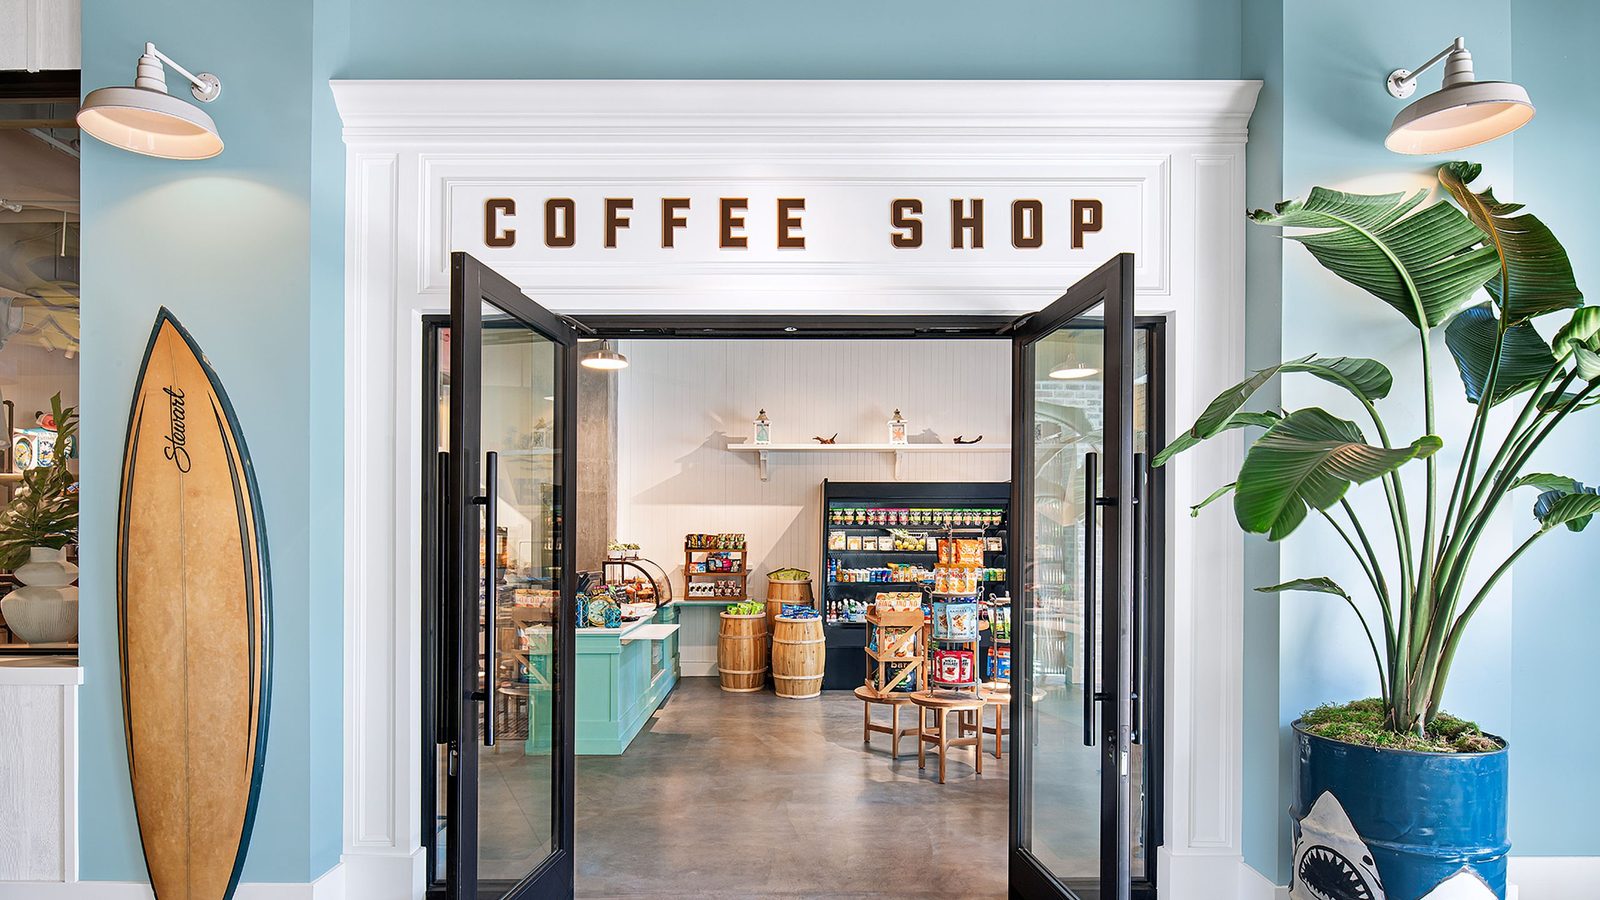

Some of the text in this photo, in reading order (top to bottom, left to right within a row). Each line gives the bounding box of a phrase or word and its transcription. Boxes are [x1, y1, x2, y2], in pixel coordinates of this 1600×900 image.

[484, 197, 1105, 249] COFFEE SHOP
[162, 385, 191, 473] Stewart
